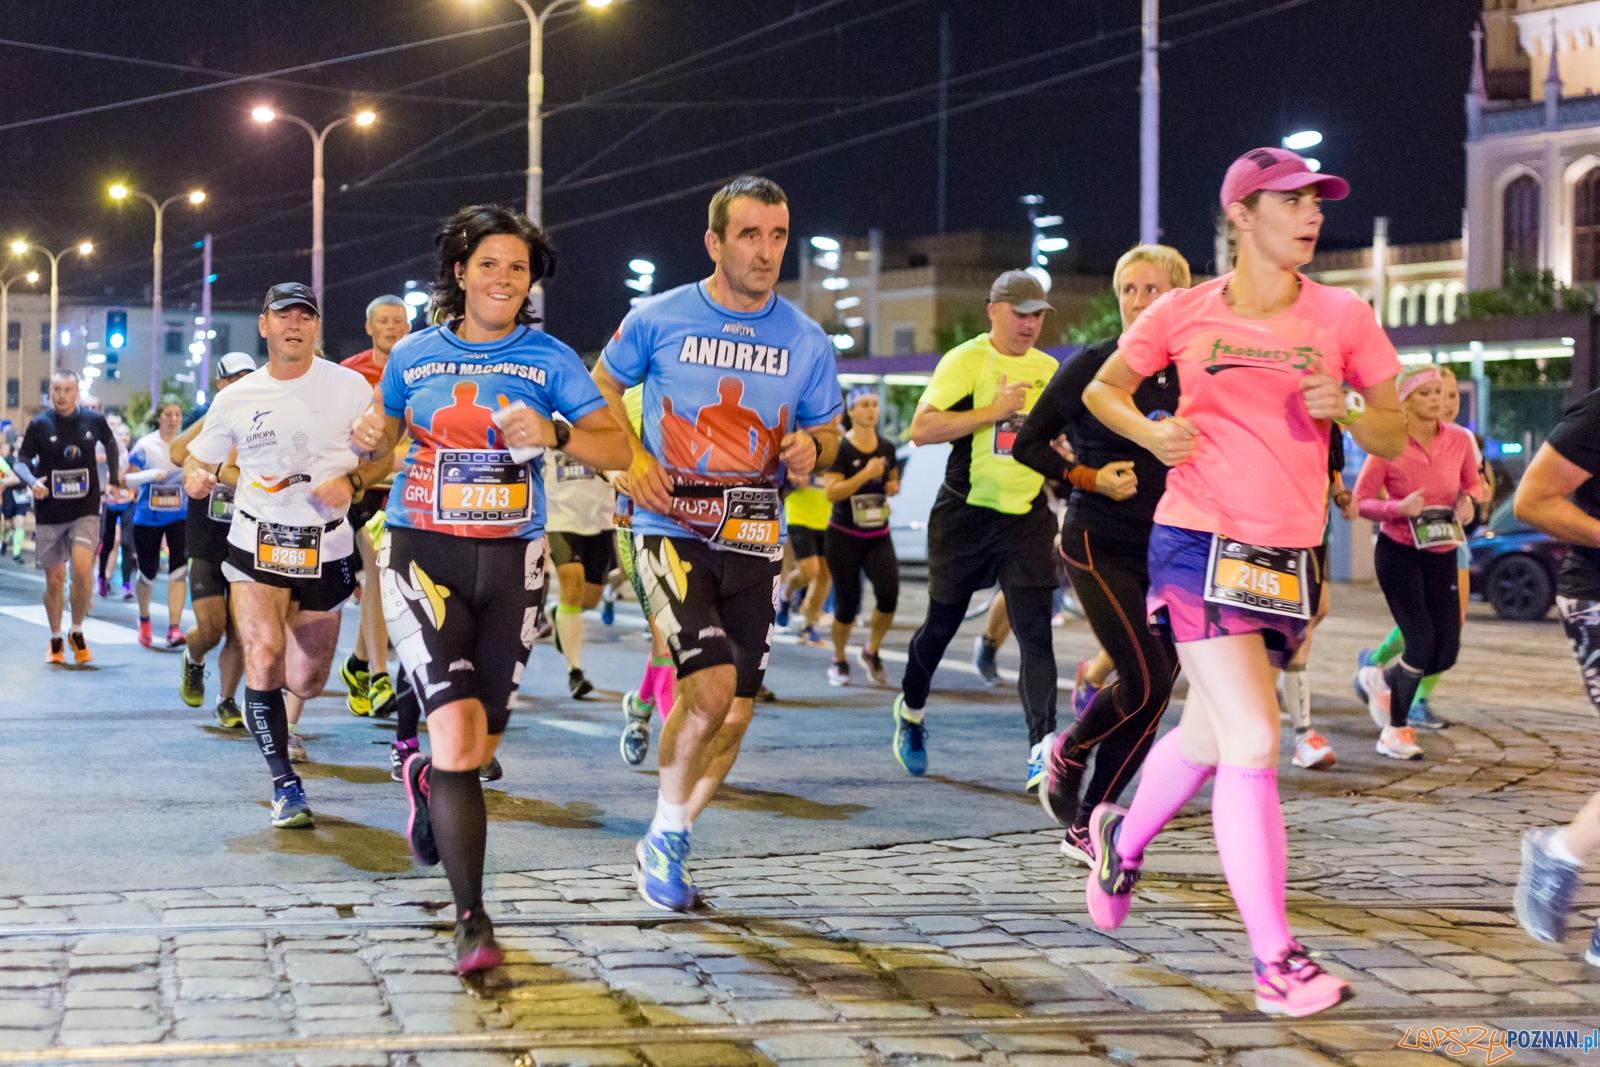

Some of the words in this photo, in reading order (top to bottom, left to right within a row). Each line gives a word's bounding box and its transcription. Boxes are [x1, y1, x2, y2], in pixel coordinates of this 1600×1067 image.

[679, 335, 790, 377] ANDRZEJ
[403, 362, 457, 386] MONIKA
[458, 362, 547, 387] MACOWSKA
[246, 430, 276, 442] EUROPA
[248, 440, 278, 450] MARATHON
[288, 475, 303, 484] 2015
[460, 486, 510, 508] 2743
[736, 521, 773, 542] 3557
[271, 547, 306, 566] 8269
[1237, 564, 1281, 597] 2145
